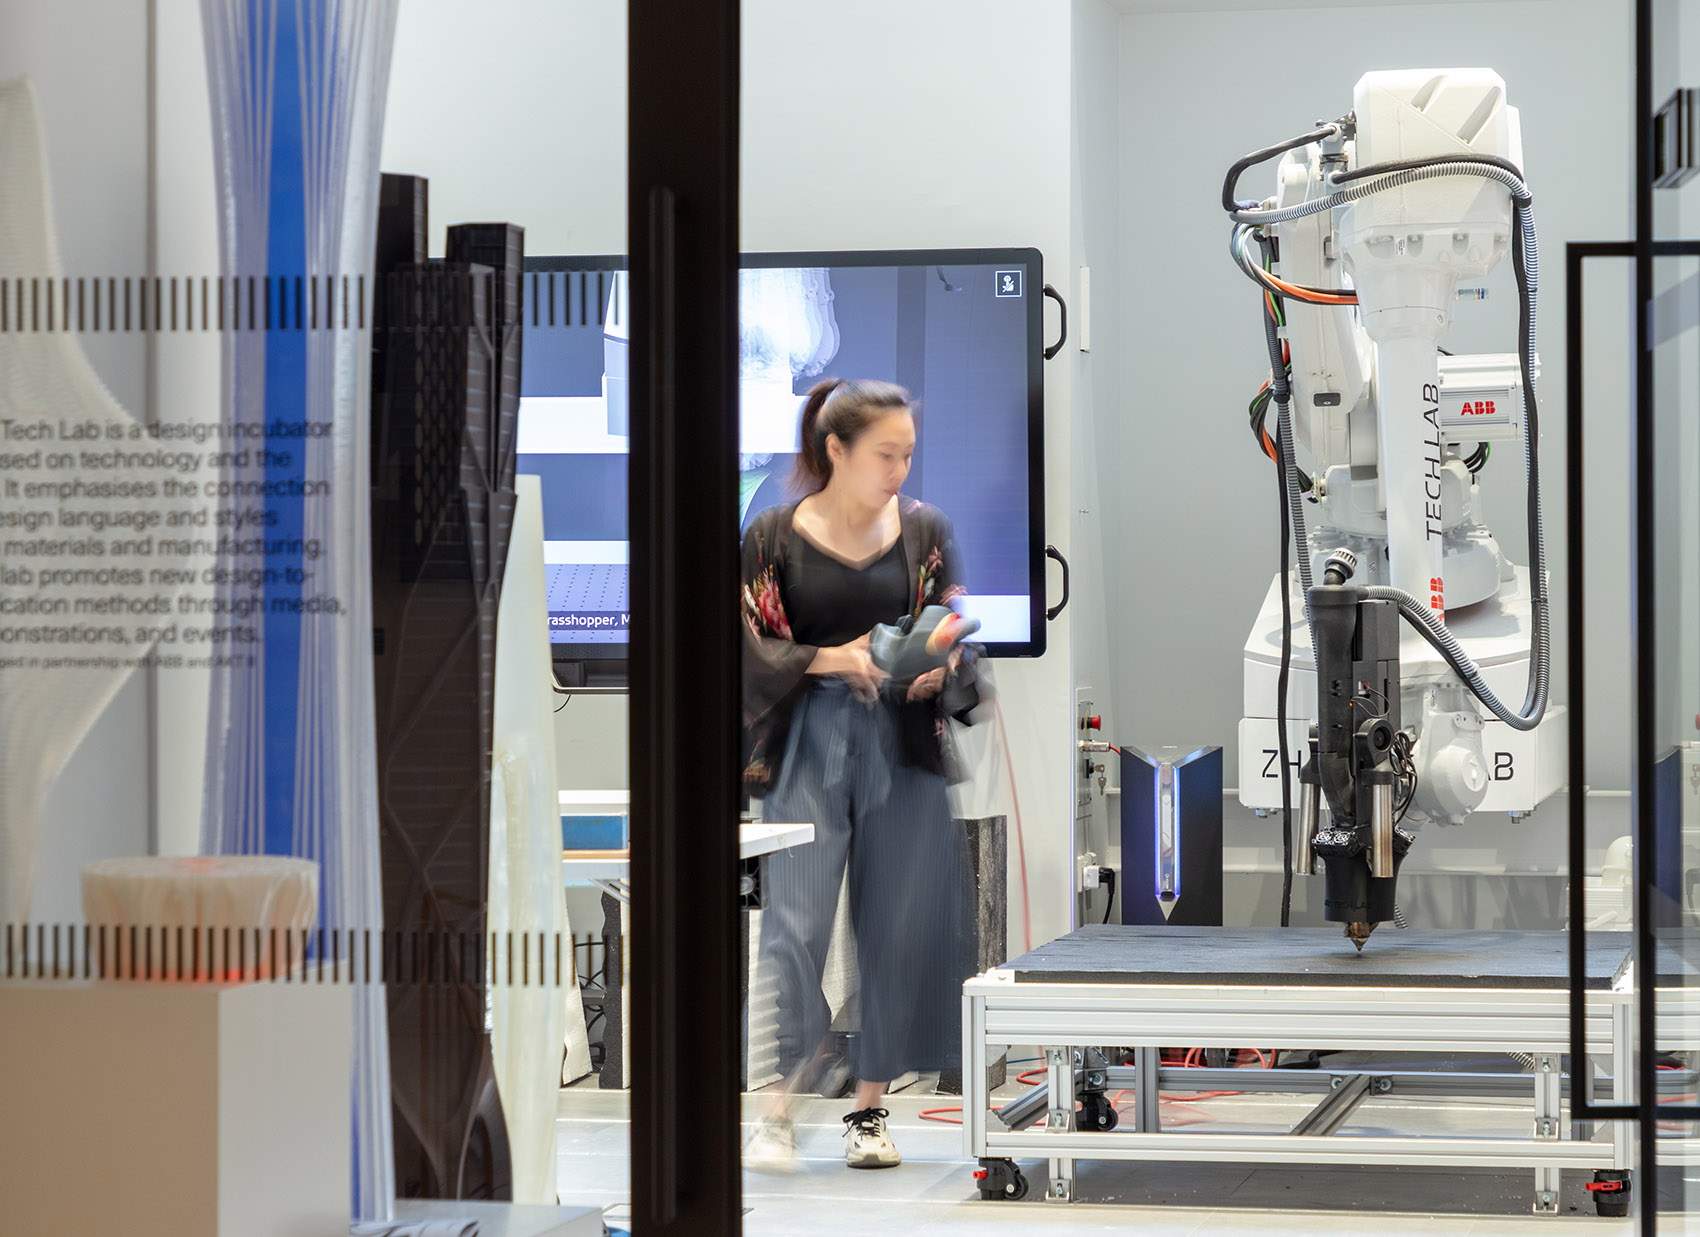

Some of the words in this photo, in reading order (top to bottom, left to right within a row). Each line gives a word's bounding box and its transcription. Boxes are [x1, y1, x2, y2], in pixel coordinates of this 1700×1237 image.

[1423, 383, 1440, 447] LAB
[1461, 401, 1496, 416] ABB
[1, 419, 54, 441] Tech
[59, 419, 100, 441] Lab
[105, 419, 124, 441] is
[129, 423, 141, 441] a
[148, 418, 219, 446] design
[227, 417, 334, 439] incubator
[46, 453, 75, 470] on
[81, 448, 201, 472] technology
[208, 449, 249, 468] and
[256, 448, 292, 468] the
[5, 479, 19, 498] It
[24, 477, 157, 501] emphasises
[164, 478, 198, 498] the
[204, 476, 331, 498] connection
[1425, 457, 1442, 541] TECH
[58, 508, 161, 533] language
[166, 507, 208, 528] and
[214, 506, 279, 530] styles
[4, 536, 105, 557] materials
[111, 535, 152, 556] and
[0, 564, 33, 585] lab
[39, 566, 145, 590] promotes
[150, 568, 196, 585] new
[0, 594, 70, 615] cation
[74, 594, 171, 615] methods
[178, 592, 265, 619] through
[271, 593, 346, 615] media,
[1, 623, 131, 645] onstrations,
[135, 624, 177, 643] and
